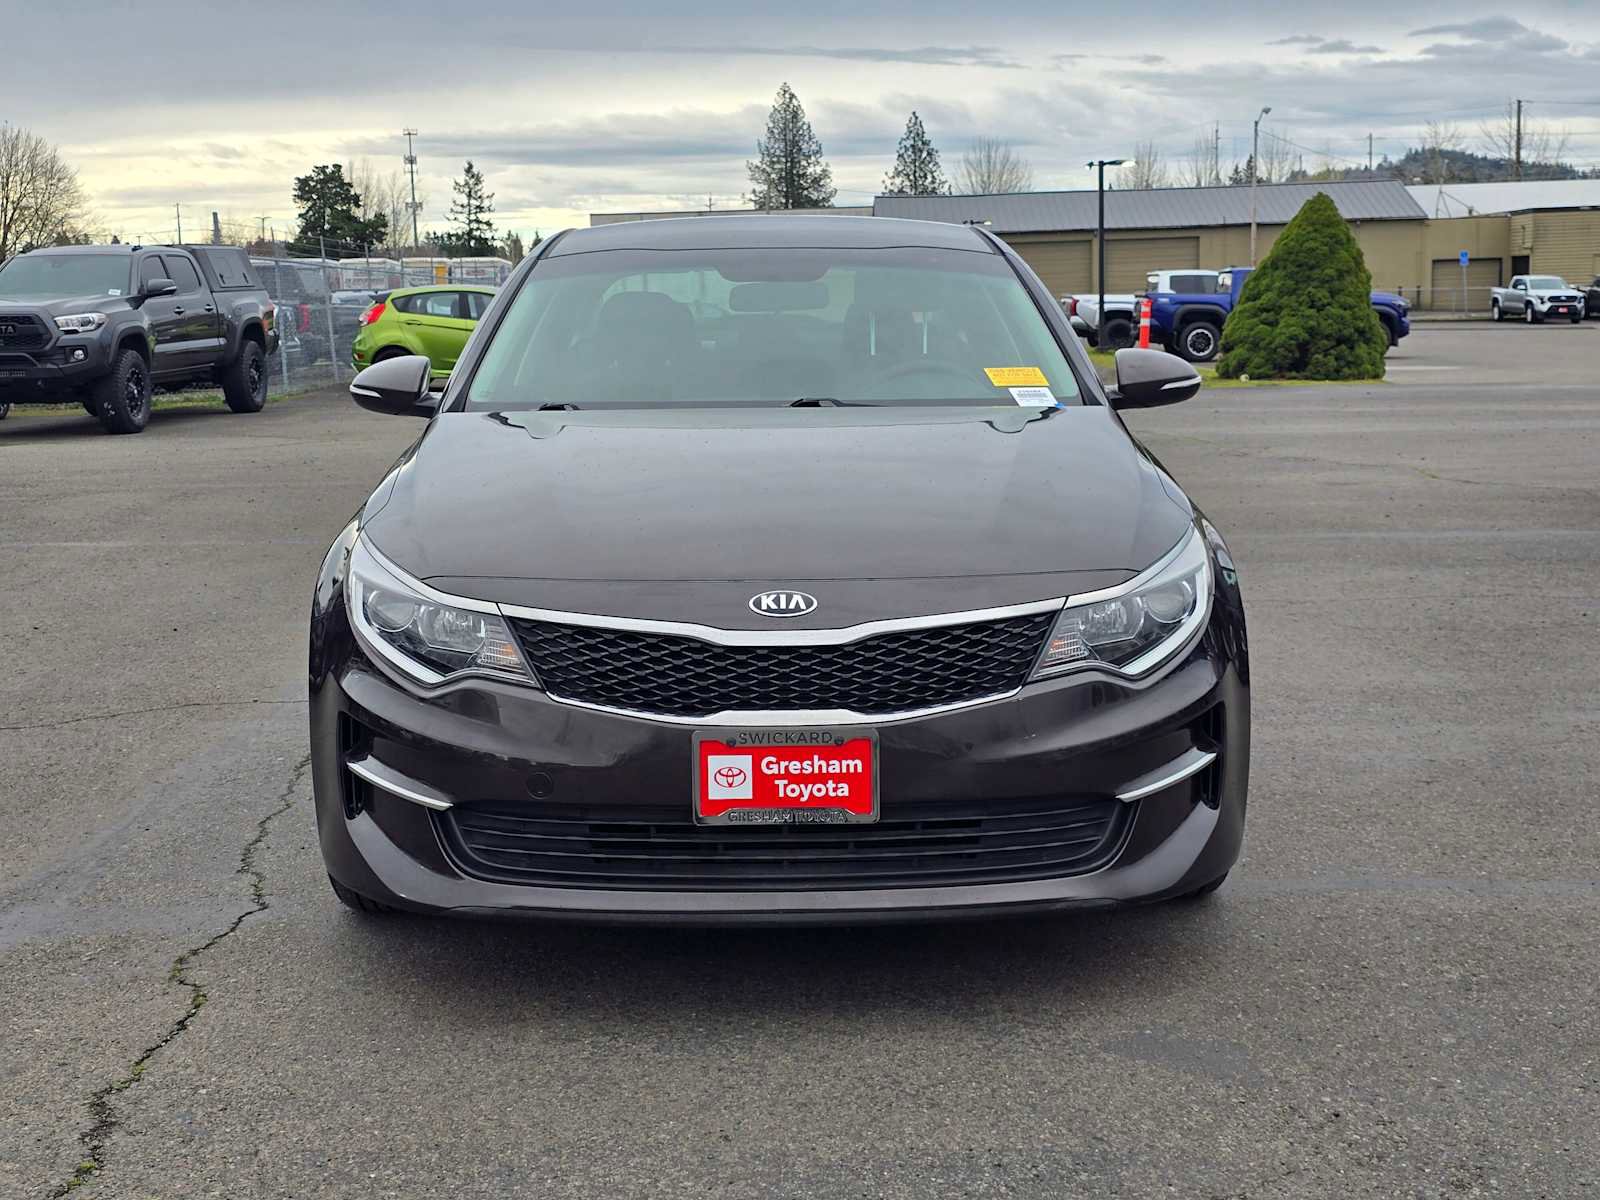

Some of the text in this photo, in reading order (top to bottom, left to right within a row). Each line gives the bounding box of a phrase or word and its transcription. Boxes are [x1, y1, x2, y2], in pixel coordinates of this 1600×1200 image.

[761, 594, 807, 610] KIA
[738, 732, 833, 745] SWICKARD
[760, 755, 863, 776] Gresham
[774, 779, 849, 802] Toyota
[728, 810, 794, 823] GRESHAM
